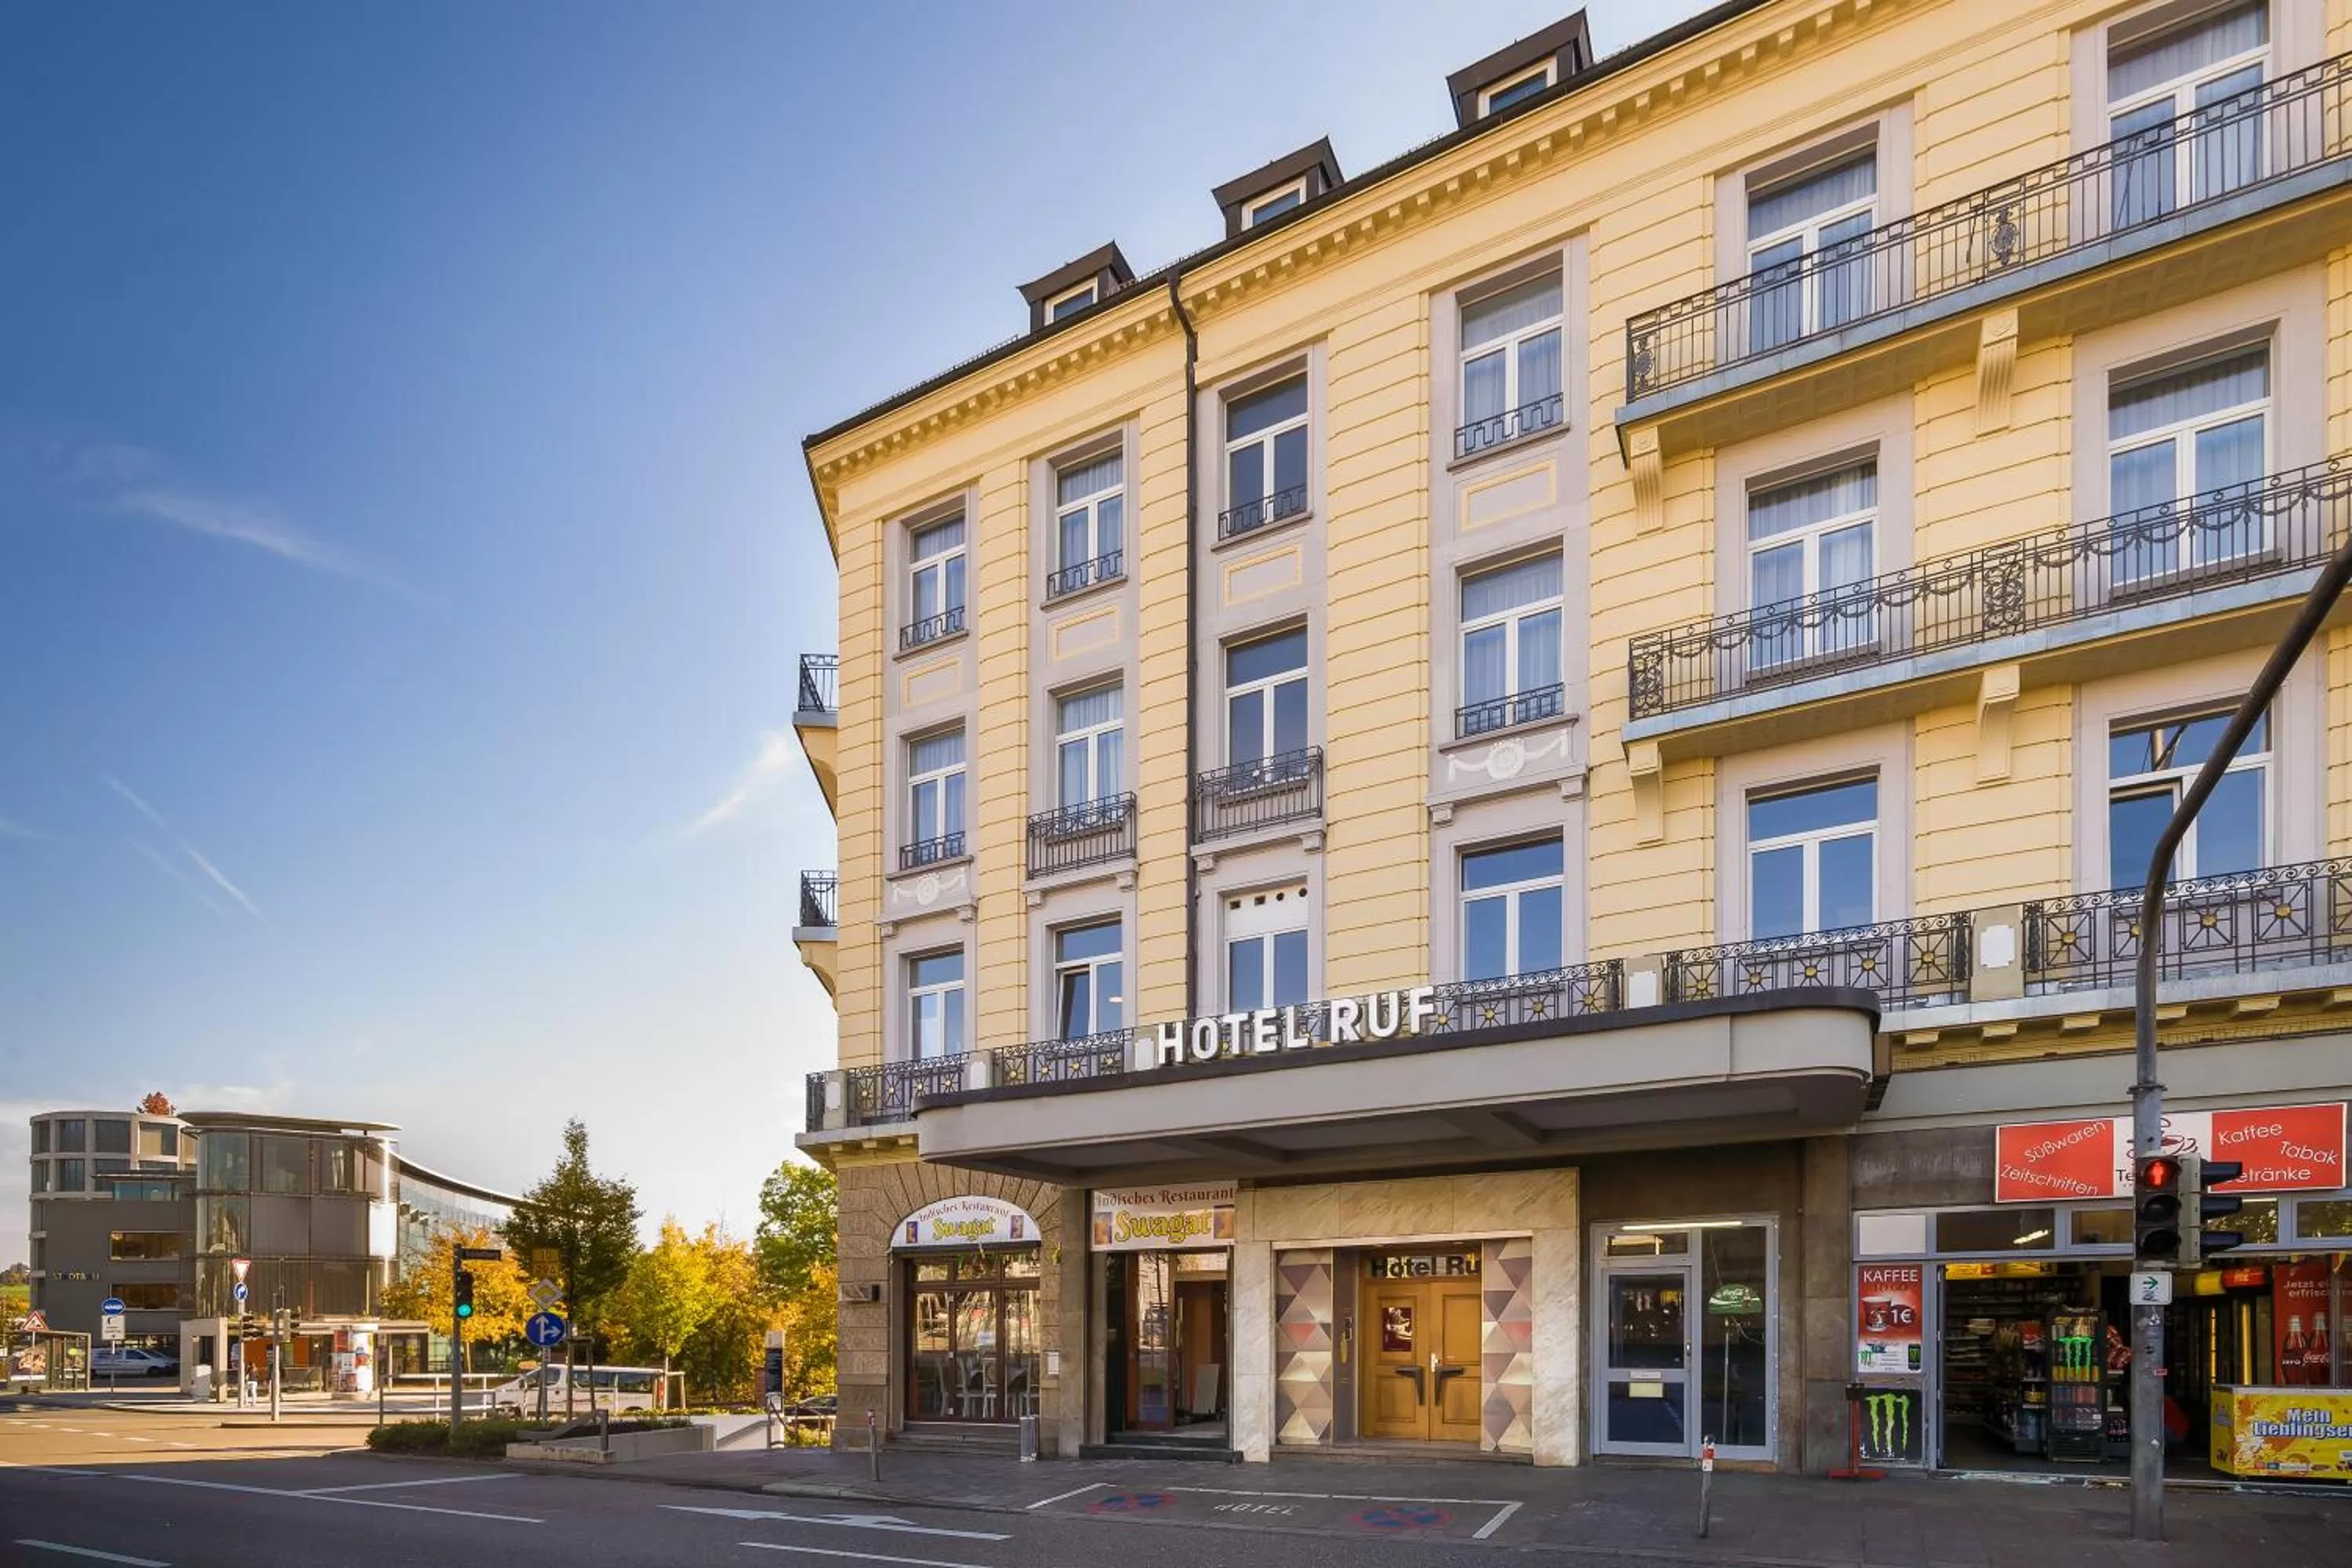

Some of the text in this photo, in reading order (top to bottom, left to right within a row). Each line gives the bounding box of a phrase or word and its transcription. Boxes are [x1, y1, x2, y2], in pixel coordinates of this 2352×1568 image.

[1157, 985, 1435, 1064] HOTEL RUF
[2024, 1121, 2107, 1163] Süßwaren
[2218, 1123, 2283, 1145] Kaffee
[2280, 1141, 2339, 1165] Tabak
[2000, 1163, 2099, 1196] Zeitschriften
[2115, 1169, 2135, 1182] Te
[2226, 1166, 2311, 1183] etränke
[1098, 1187, 1235, 1207] Indisches Restaurant
[917, 1201, 1010, 1221] Indisches Restaurant
[931, 1217, 996, 1241] Swagat
[1114, 1209, 1214, 1243] Swagat
[1371, 1254, 1481, 1277] Hotel Ru
[1863, 1269, 1918, 1283] KAFFEE
[2288, 1288, 2330, 1298] erfrisc
[1890, 1308, 1913, 1324] 1€
[2286, 1407, 2332, 1424] Mein
[1213, 1503, 1294, 1515] HOTEL
